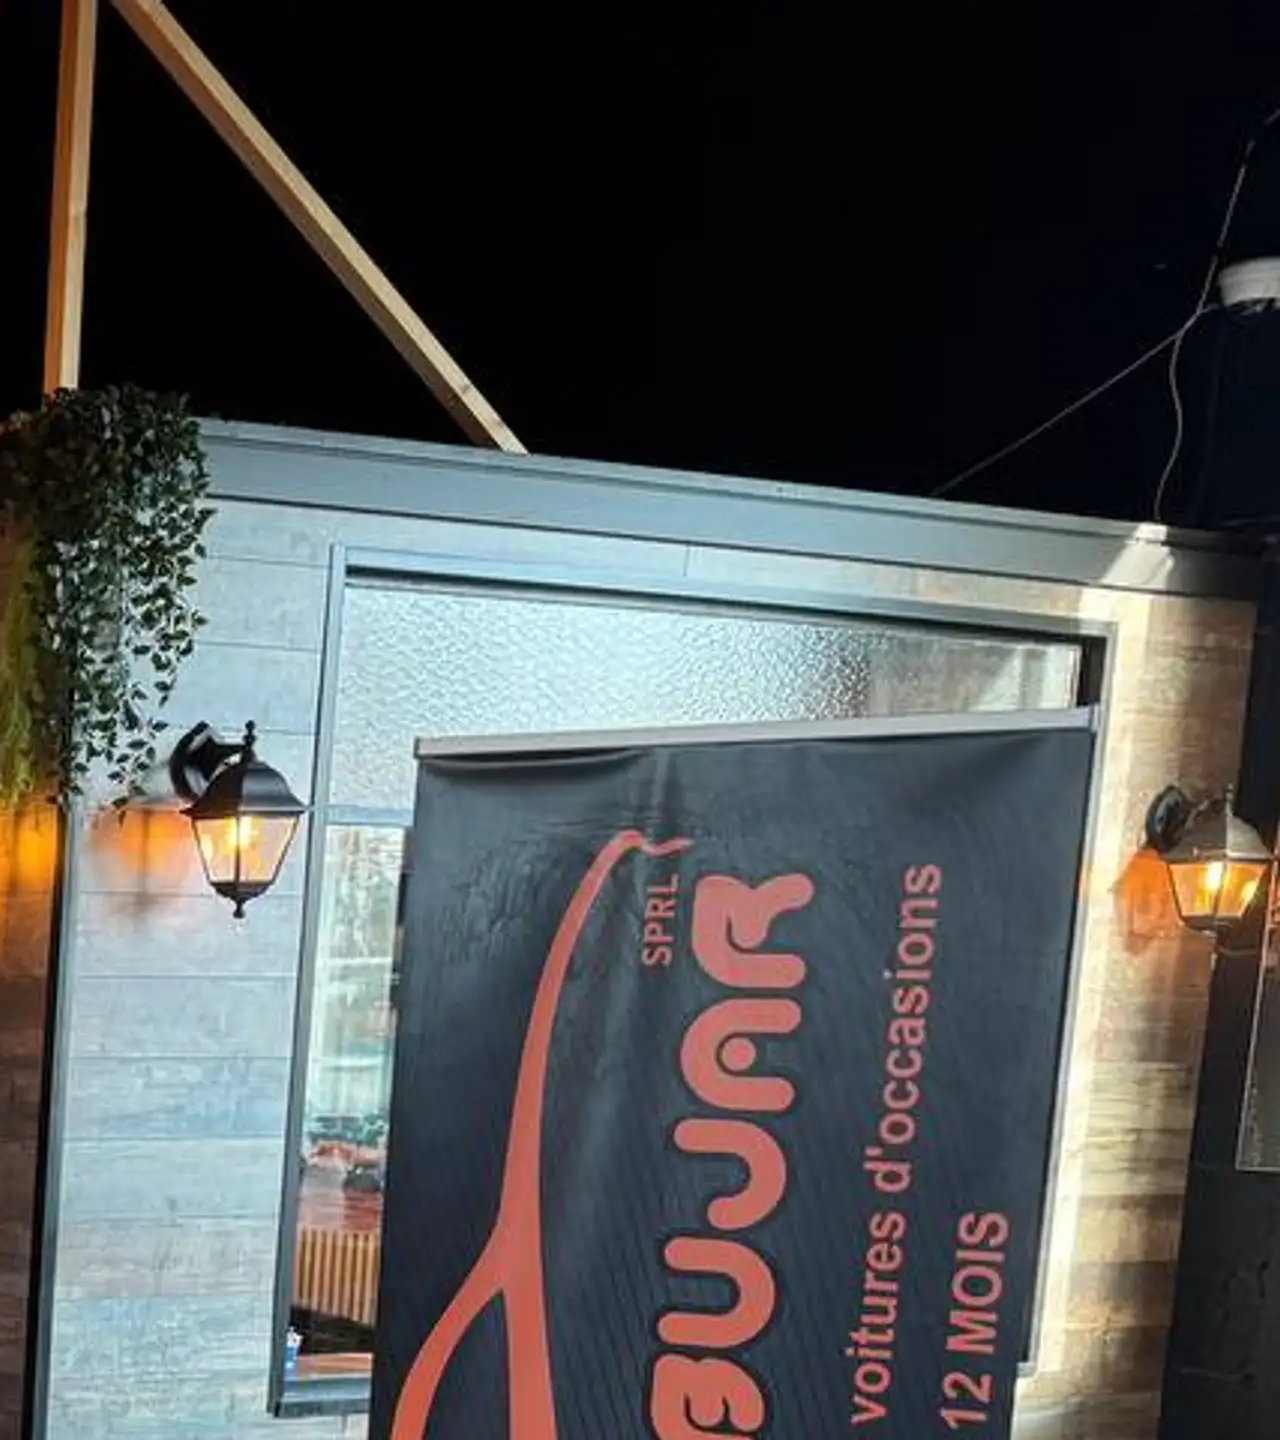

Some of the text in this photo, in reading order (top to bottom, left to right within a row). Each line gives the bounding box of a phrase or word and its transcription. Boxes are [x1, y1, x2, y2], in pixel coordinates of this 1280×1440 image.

[642, 873, 680, 968] SPRL
[863, 863, 942, 1194] d'occasions
[843, 1211, 907, 1426] voitures
[945, 1210, 1010, 1355] MOIS
[939, 1370, 994, 1431] 12
